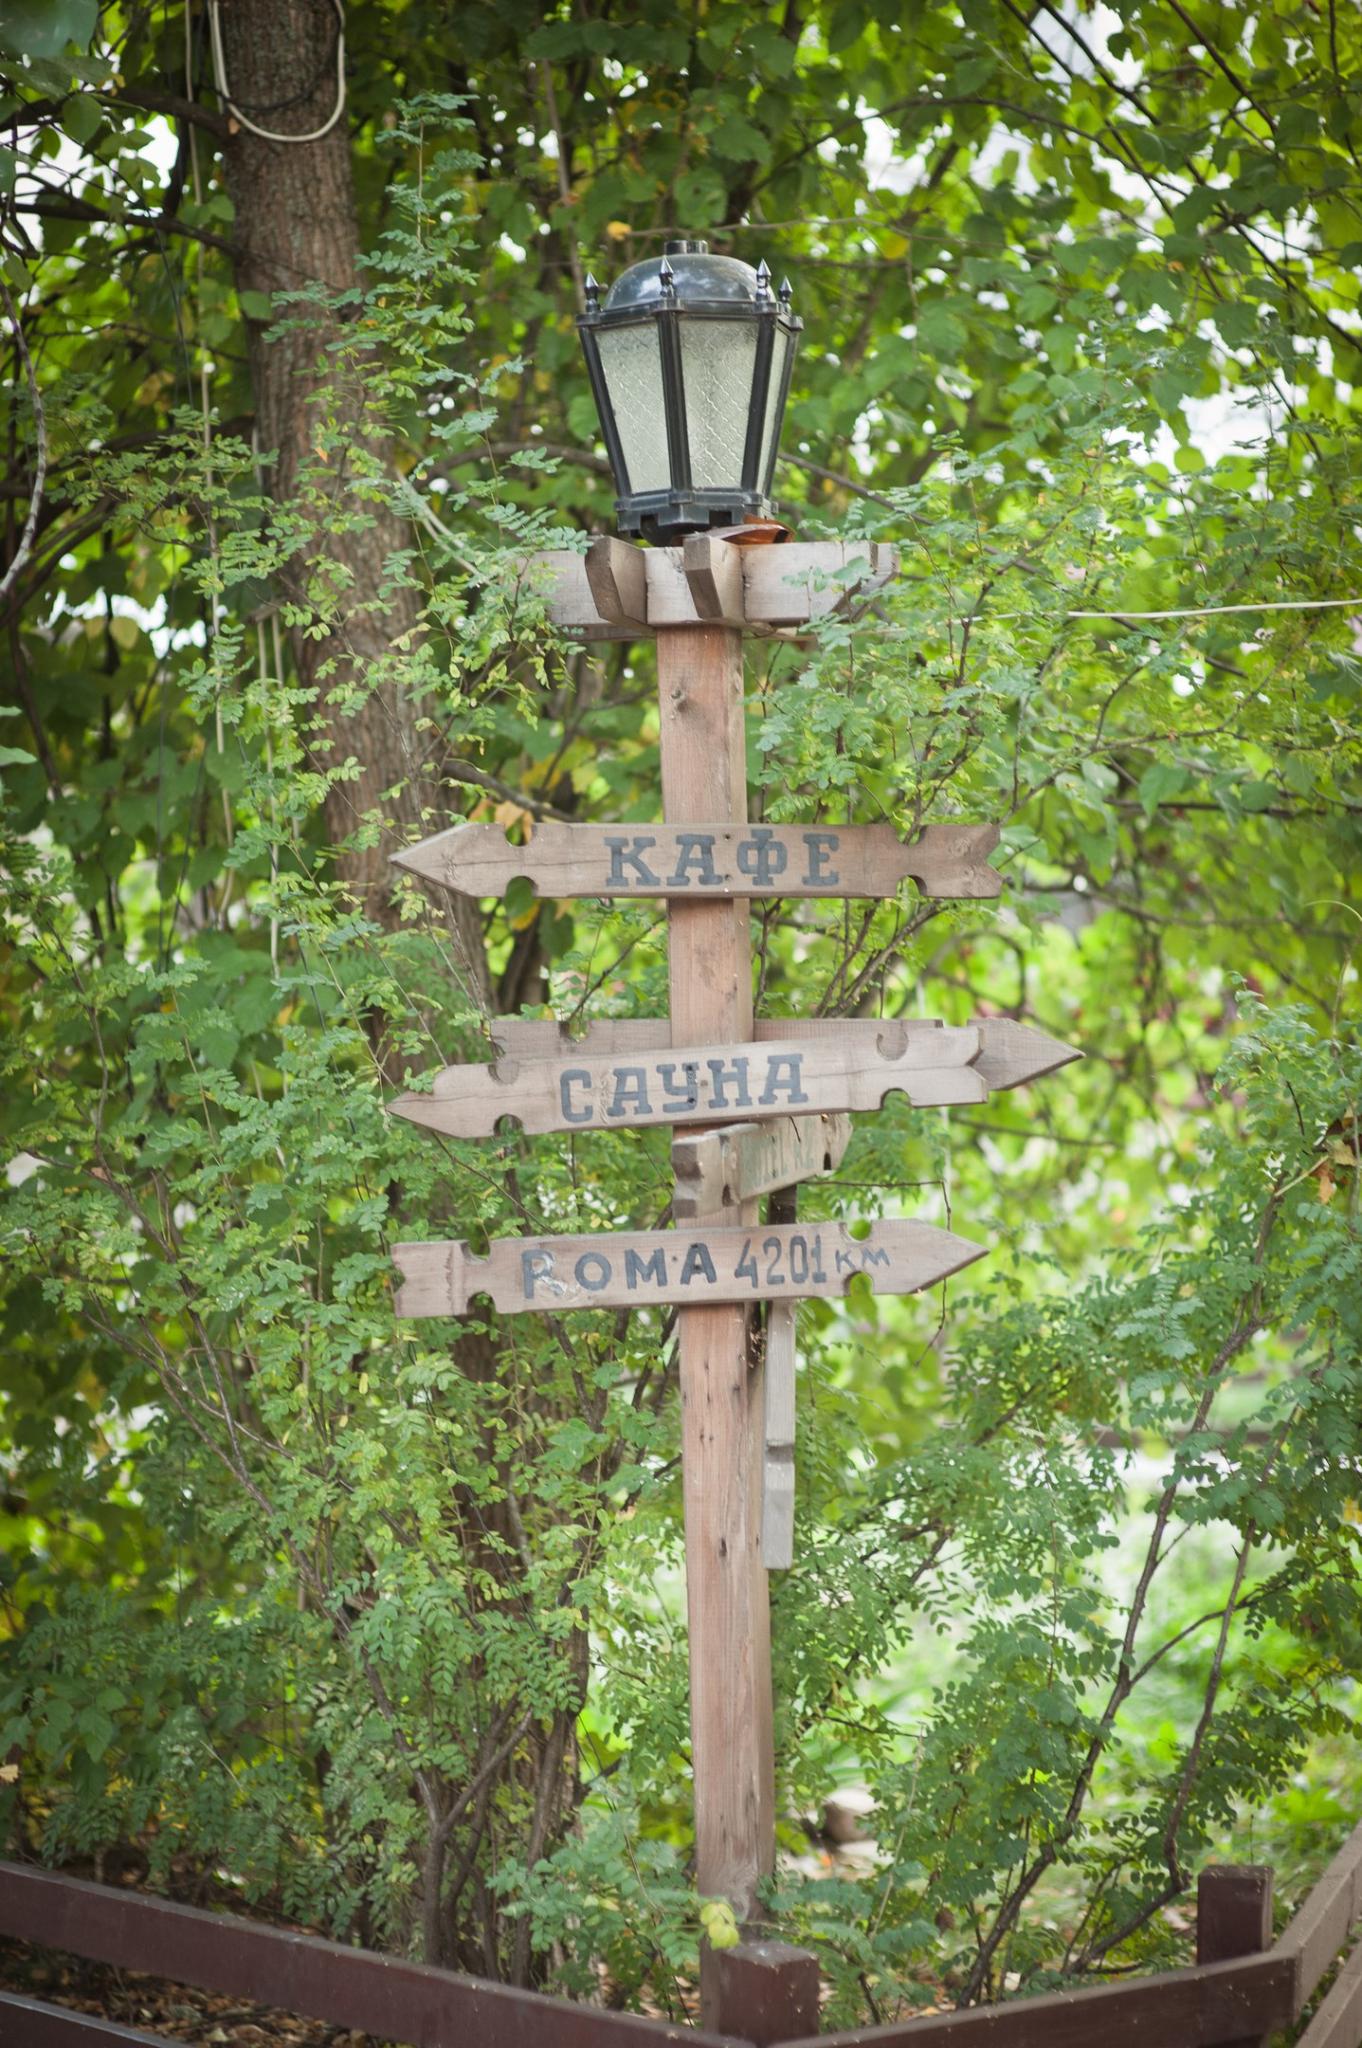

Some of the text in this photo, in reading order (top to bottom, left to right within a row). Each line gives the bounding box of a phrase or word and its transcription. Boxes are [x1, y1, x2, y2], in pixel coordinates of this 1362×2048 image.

[604, 829, 839, 886] КАФЕ
[560, 1054, 808, 1123] САУНА
[734, 1234, 827, 1289] 4201
